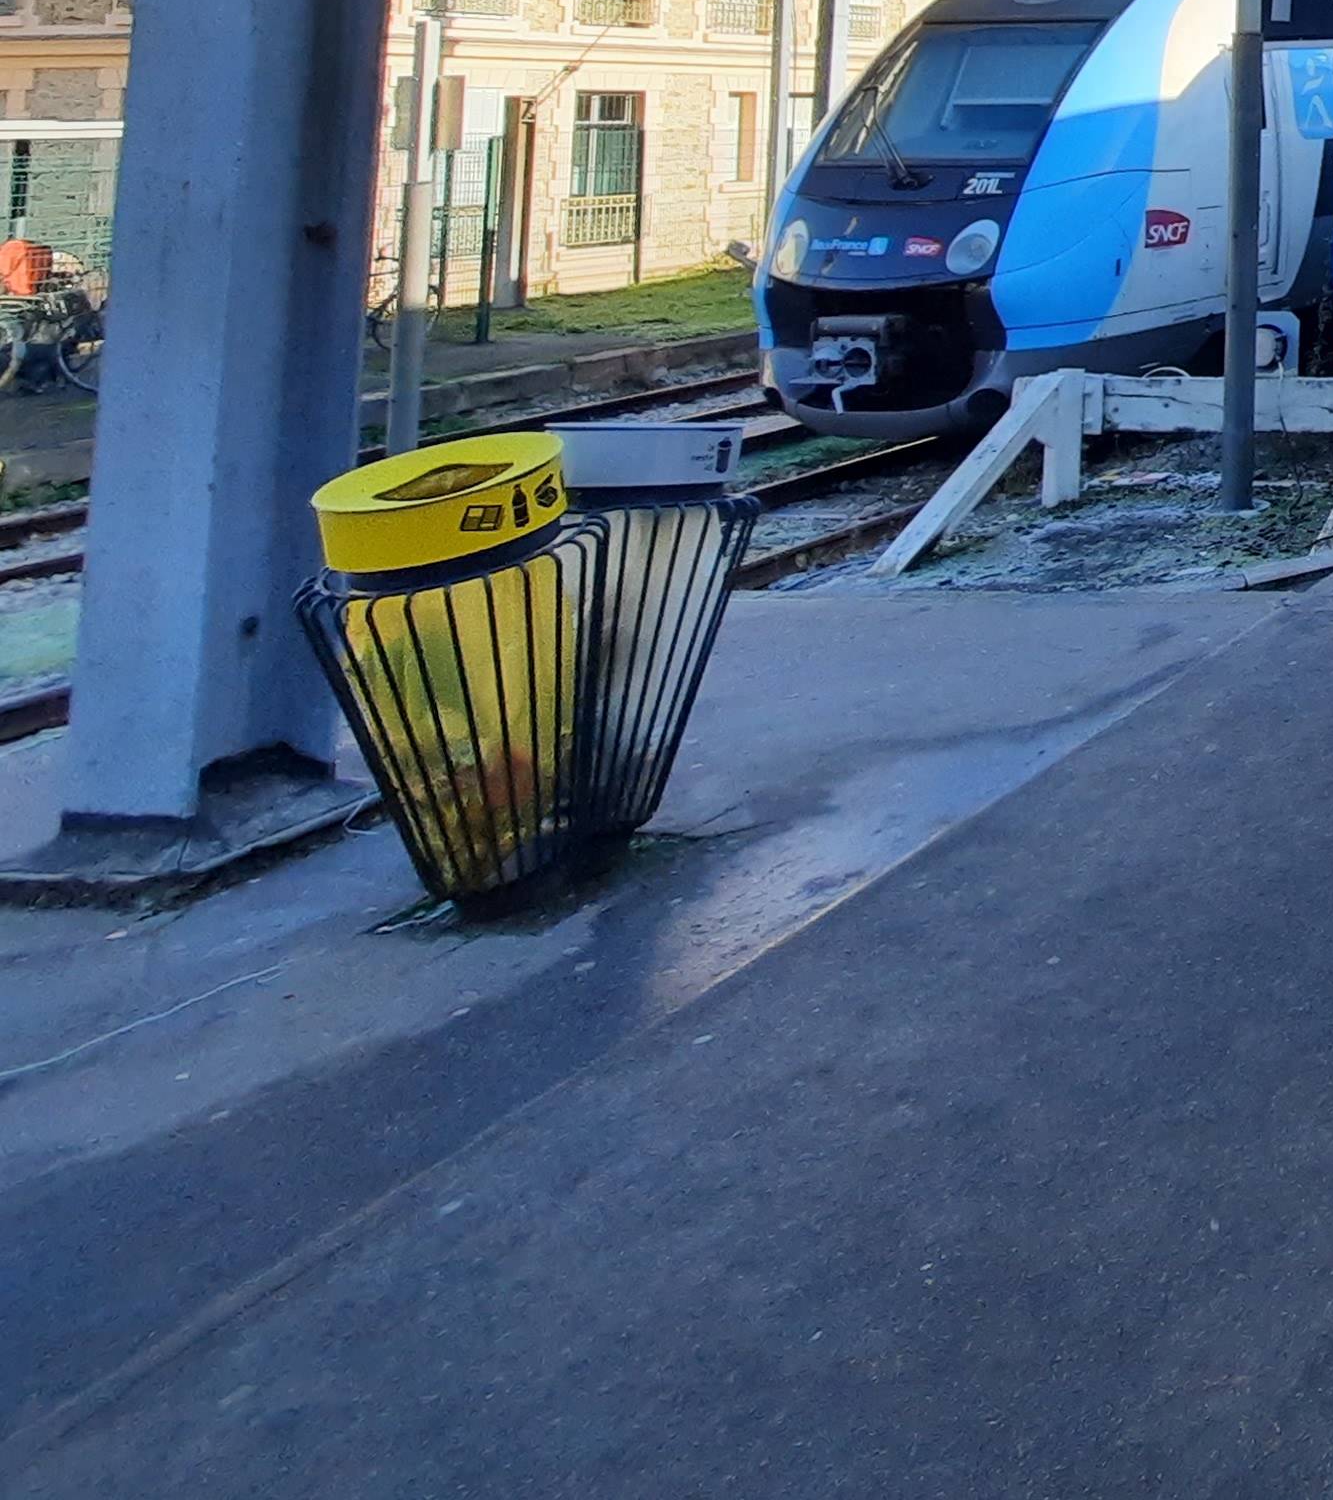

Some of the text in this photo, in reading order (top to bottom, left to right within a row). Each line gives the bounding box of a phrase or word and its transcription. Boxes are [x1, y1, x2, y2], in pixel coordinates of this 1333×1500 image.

[963, 177, 1003, 195] 201L
[1146, 221, 1188, 243] SNCF
[905, 243, 940, 255] SNCF
